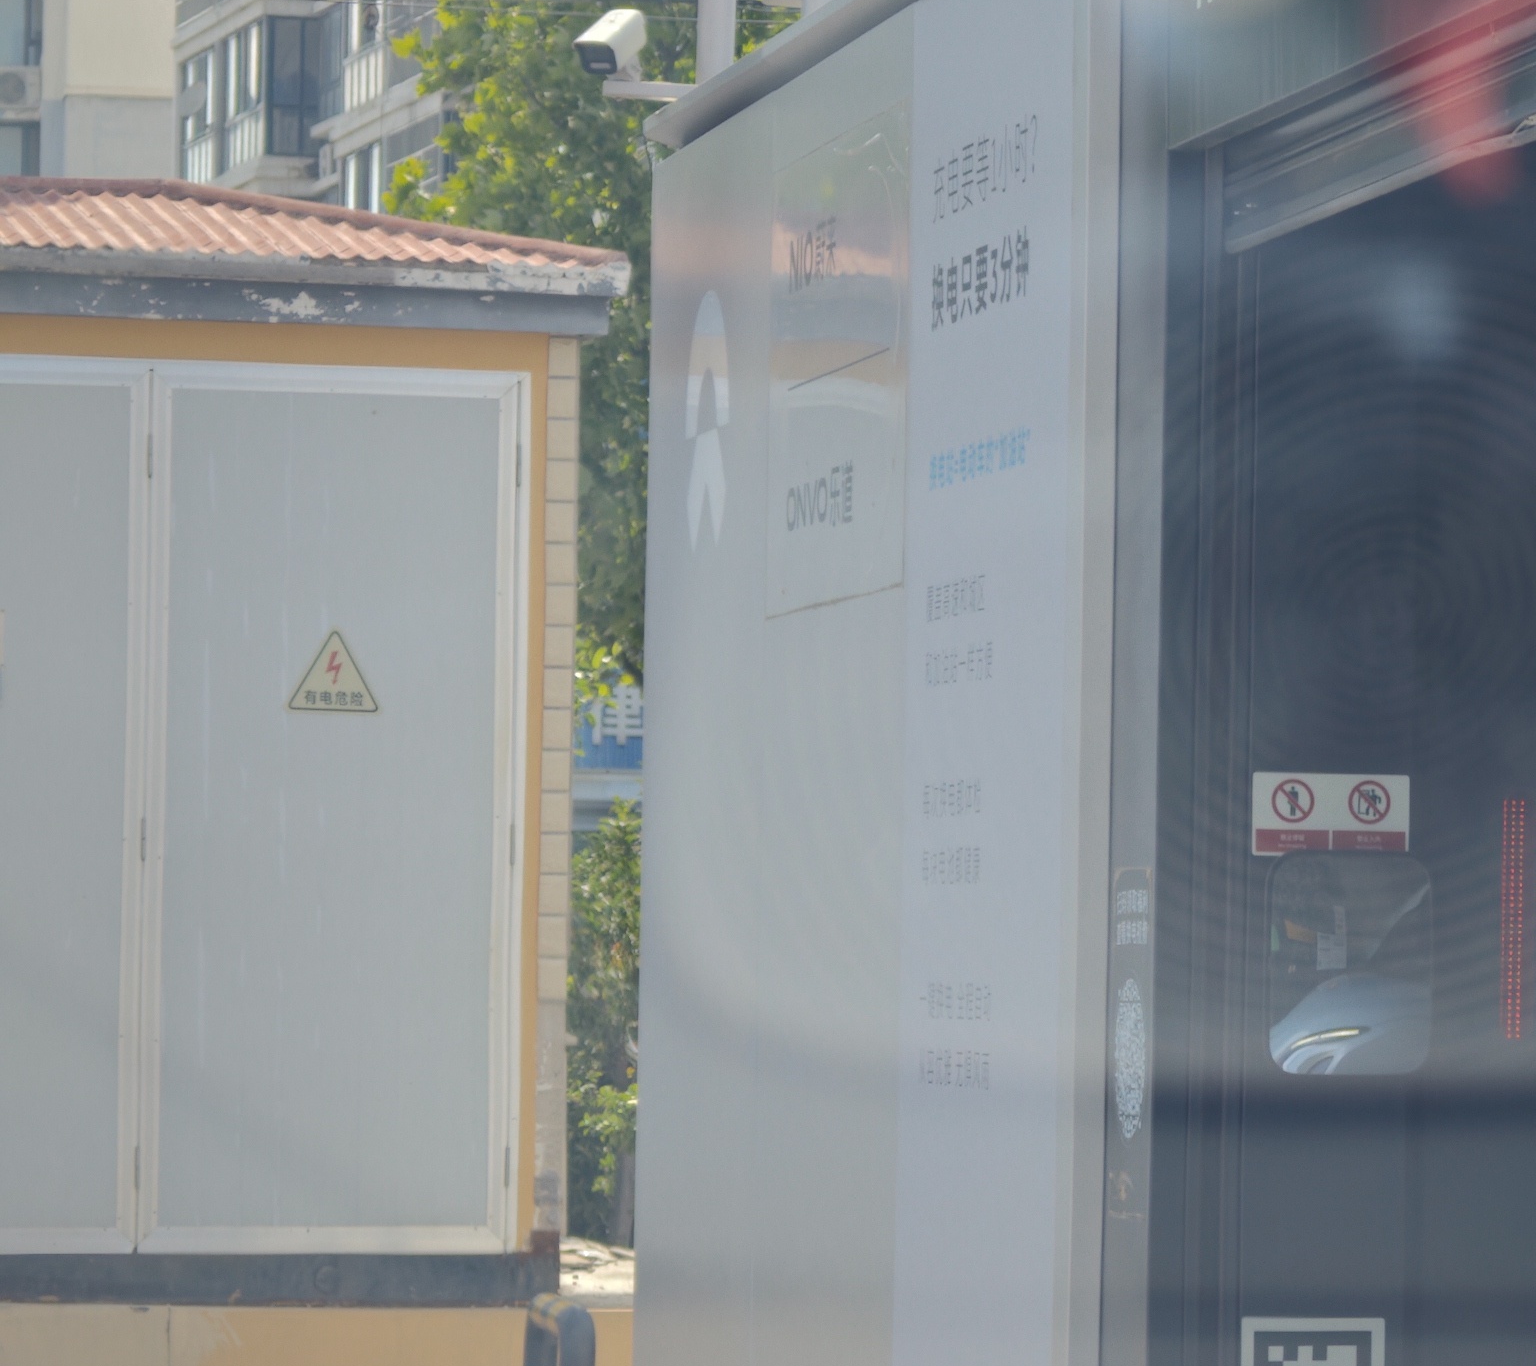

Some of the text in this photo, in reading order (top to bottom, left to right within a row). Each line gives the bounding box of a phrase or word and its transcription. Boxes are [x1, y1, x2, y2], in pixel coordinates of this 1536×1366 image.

[931, 225, 1030, 333] 换电只要3分钟
[303, 689, 364, 707] 有电危险
